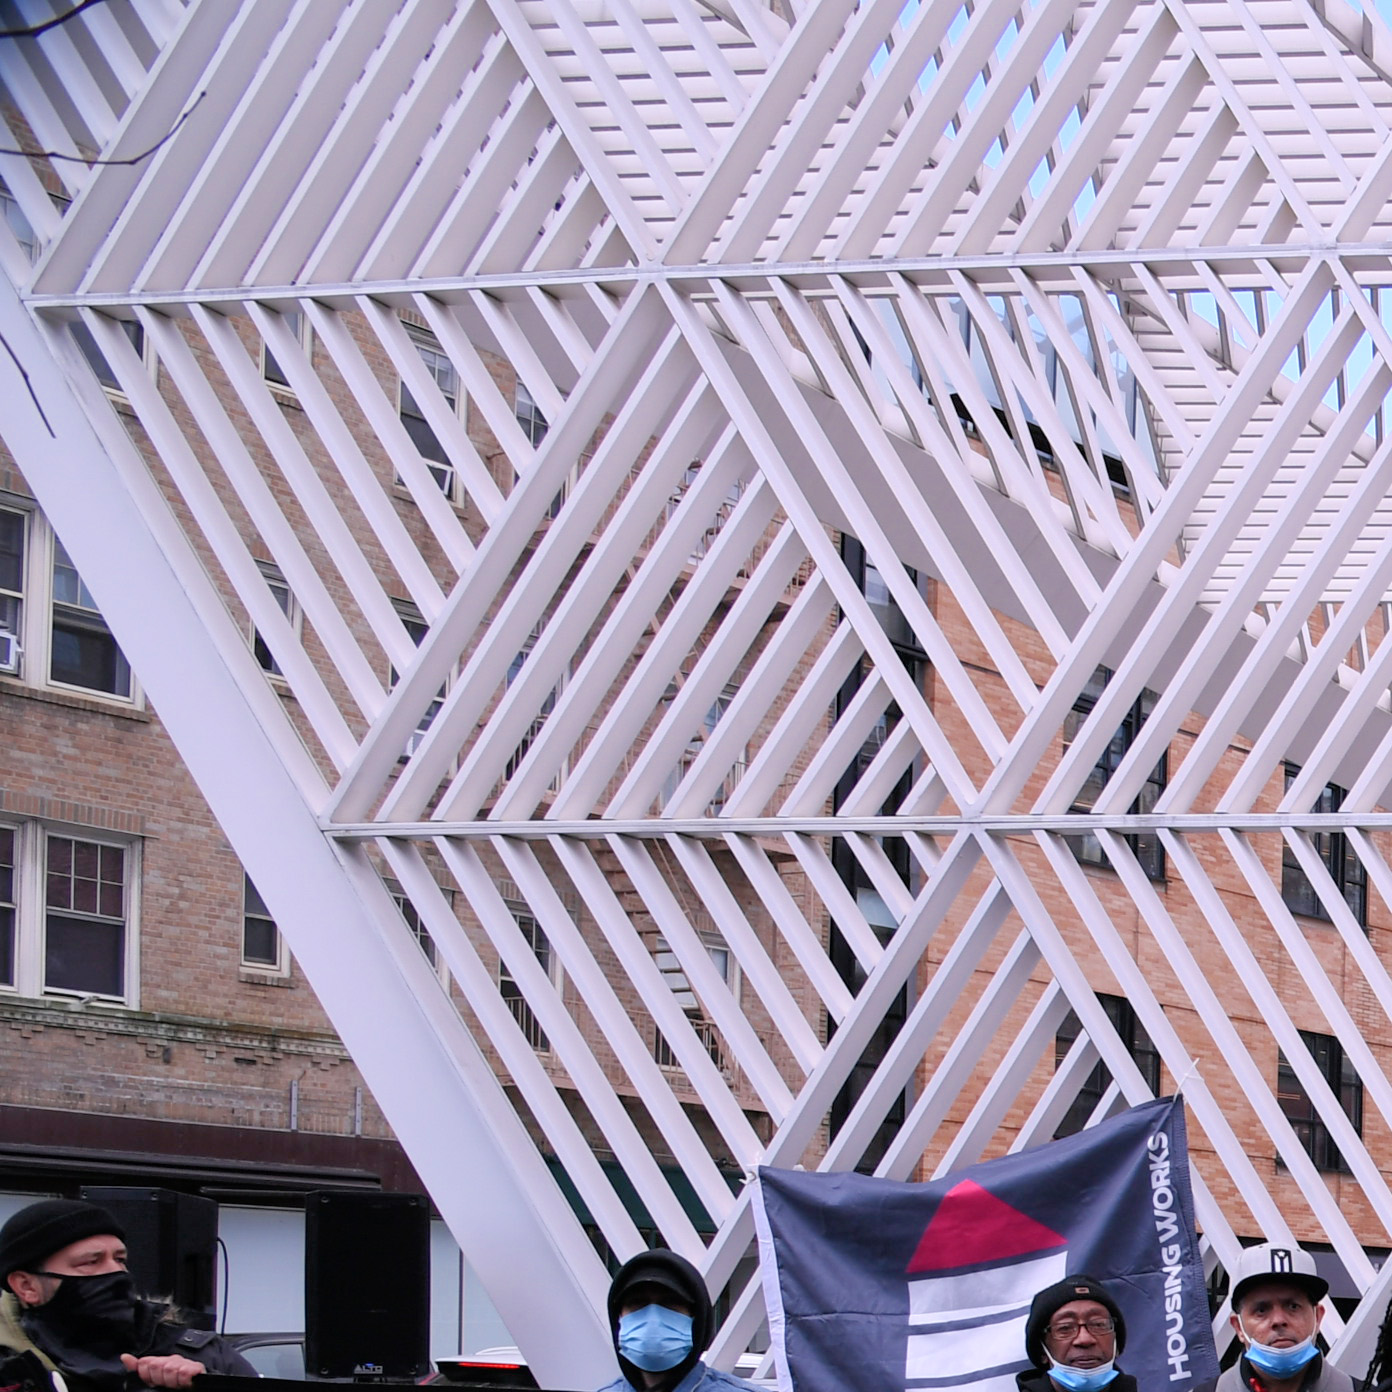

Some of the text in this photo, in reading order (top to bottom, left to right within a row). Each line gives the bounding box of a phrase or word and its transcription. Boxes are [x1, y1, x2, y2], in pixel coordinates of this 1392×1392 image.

[1147, 1131, 1192, 1382] HOUSING WORKS
[354, 1364, 383, 1374] ALTO
